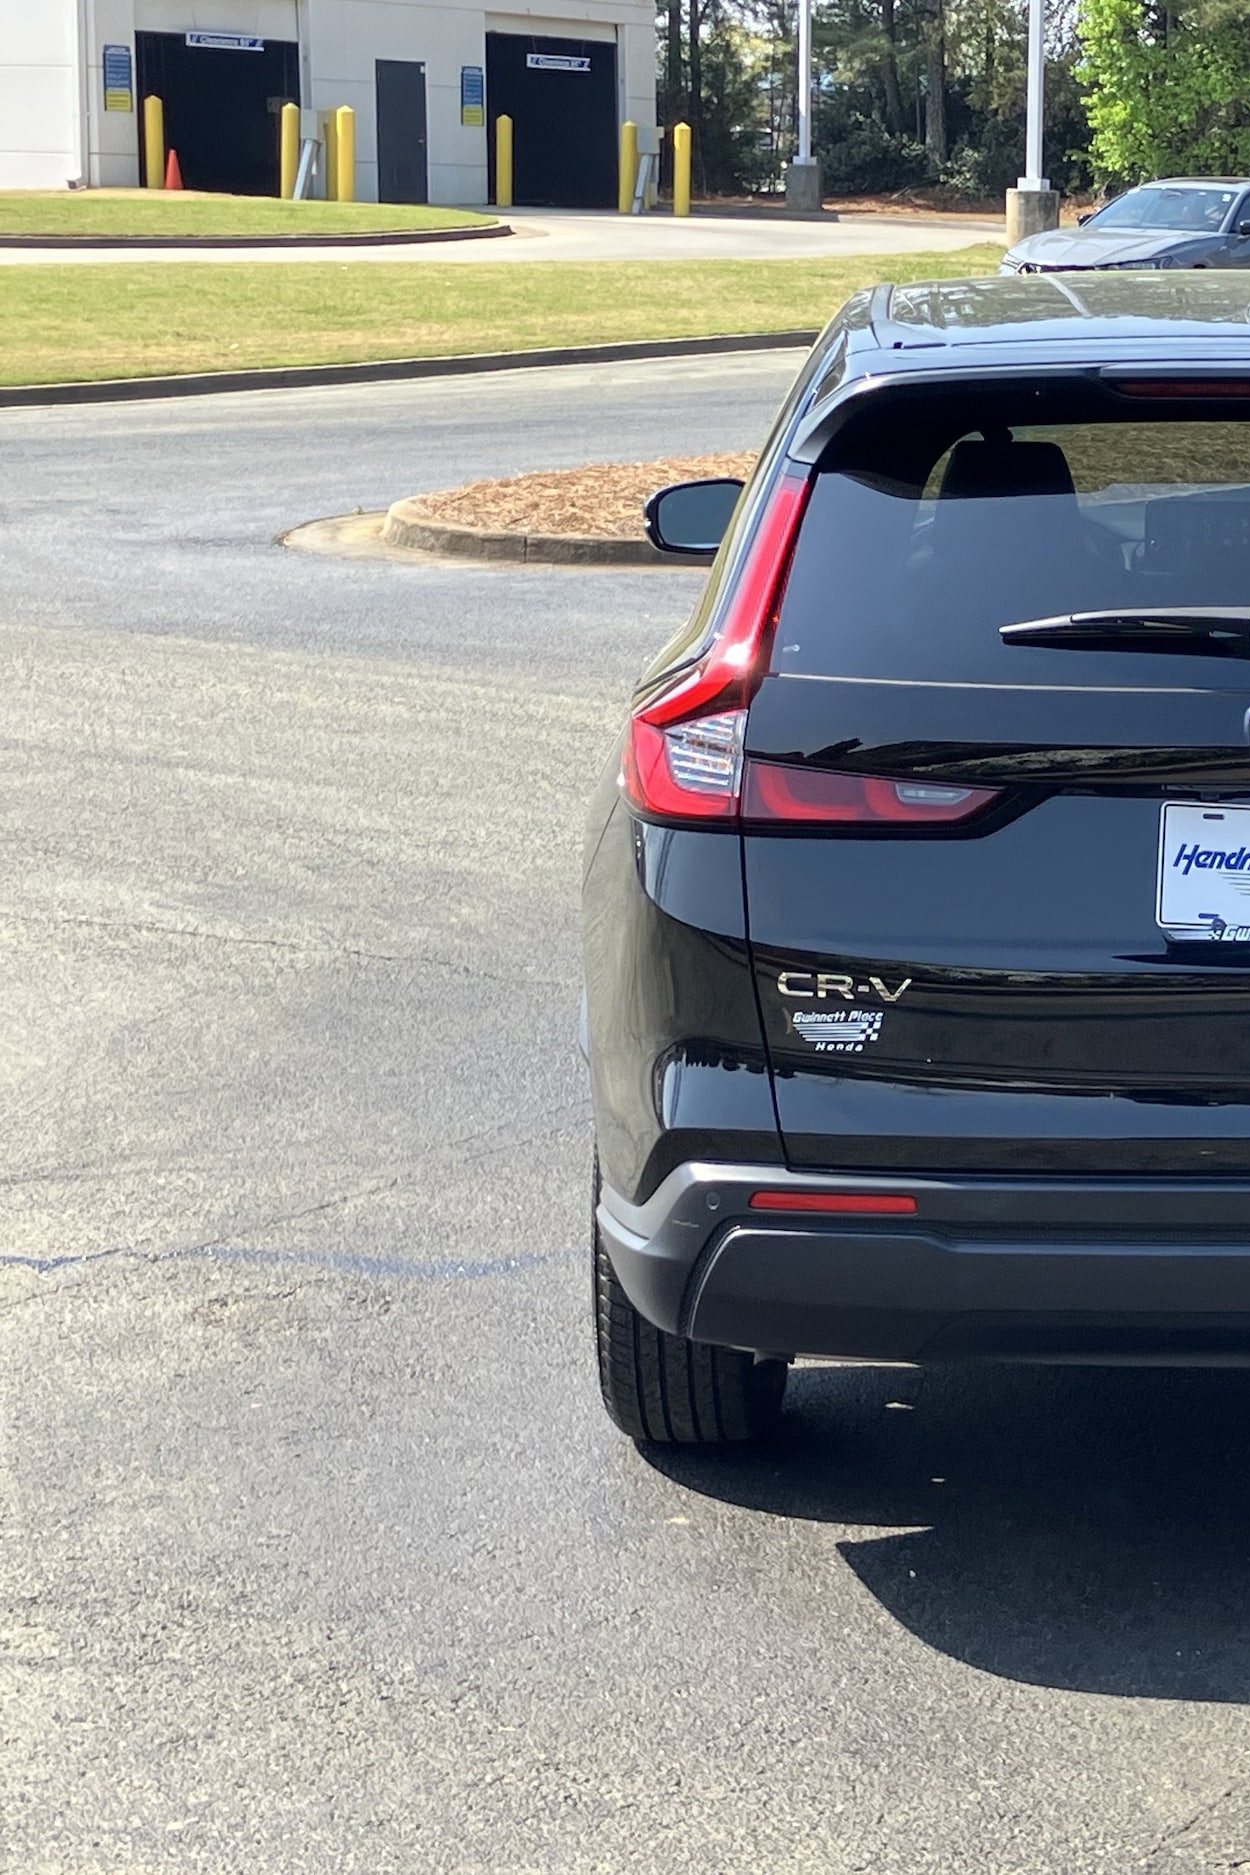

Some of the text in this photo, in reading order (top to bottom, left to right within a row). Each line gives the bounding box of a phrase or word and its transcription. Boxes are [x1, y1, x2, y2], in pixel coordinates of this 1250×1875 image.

[776, 971, 913, 1002] CR-V
[792, 1010, 884, 1024] Gwinnett Place
[815, 1041, 864, 1052] Honda
